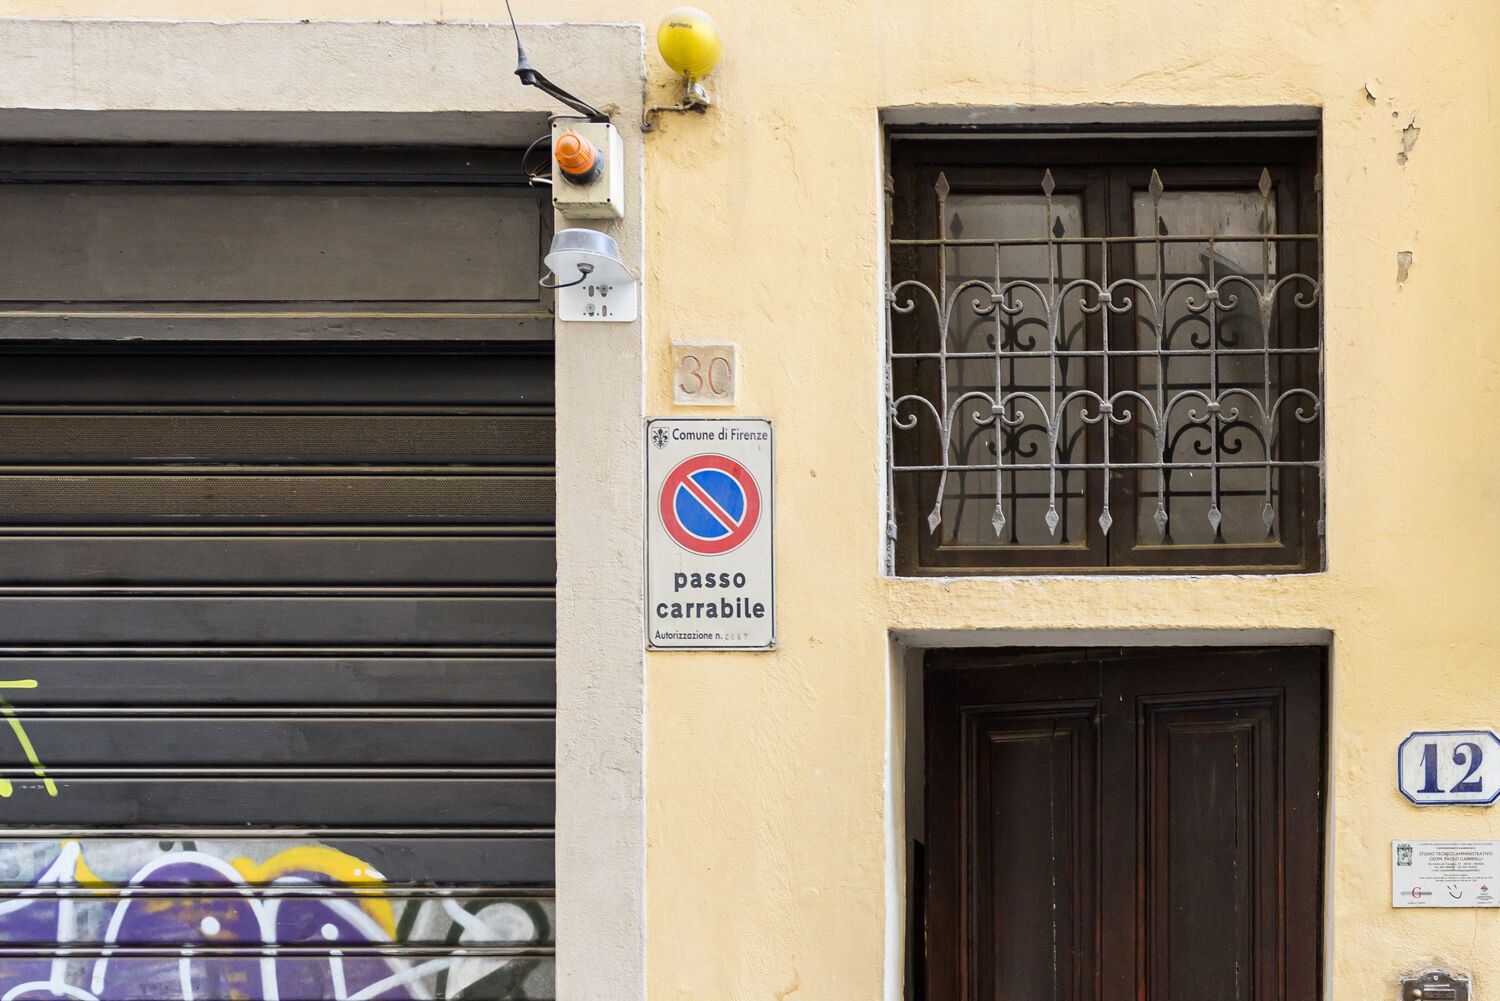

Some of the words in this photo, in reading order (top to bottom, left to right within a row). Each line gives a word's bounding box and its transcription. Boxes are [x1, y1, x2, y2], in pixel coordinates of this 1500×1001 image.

[678, 355, 732, 395] 30
[672, 428, 715, 441] Comune
[717, 428, 728, 441] di
[730, 428, 768, 441] Firenze
[674, 571, 747, 592] passo
[656, 597, 766, 619] carrabile
[655, 630, 713, 640] Autorizzazione
[1416, 742, 1484, 794] 12
